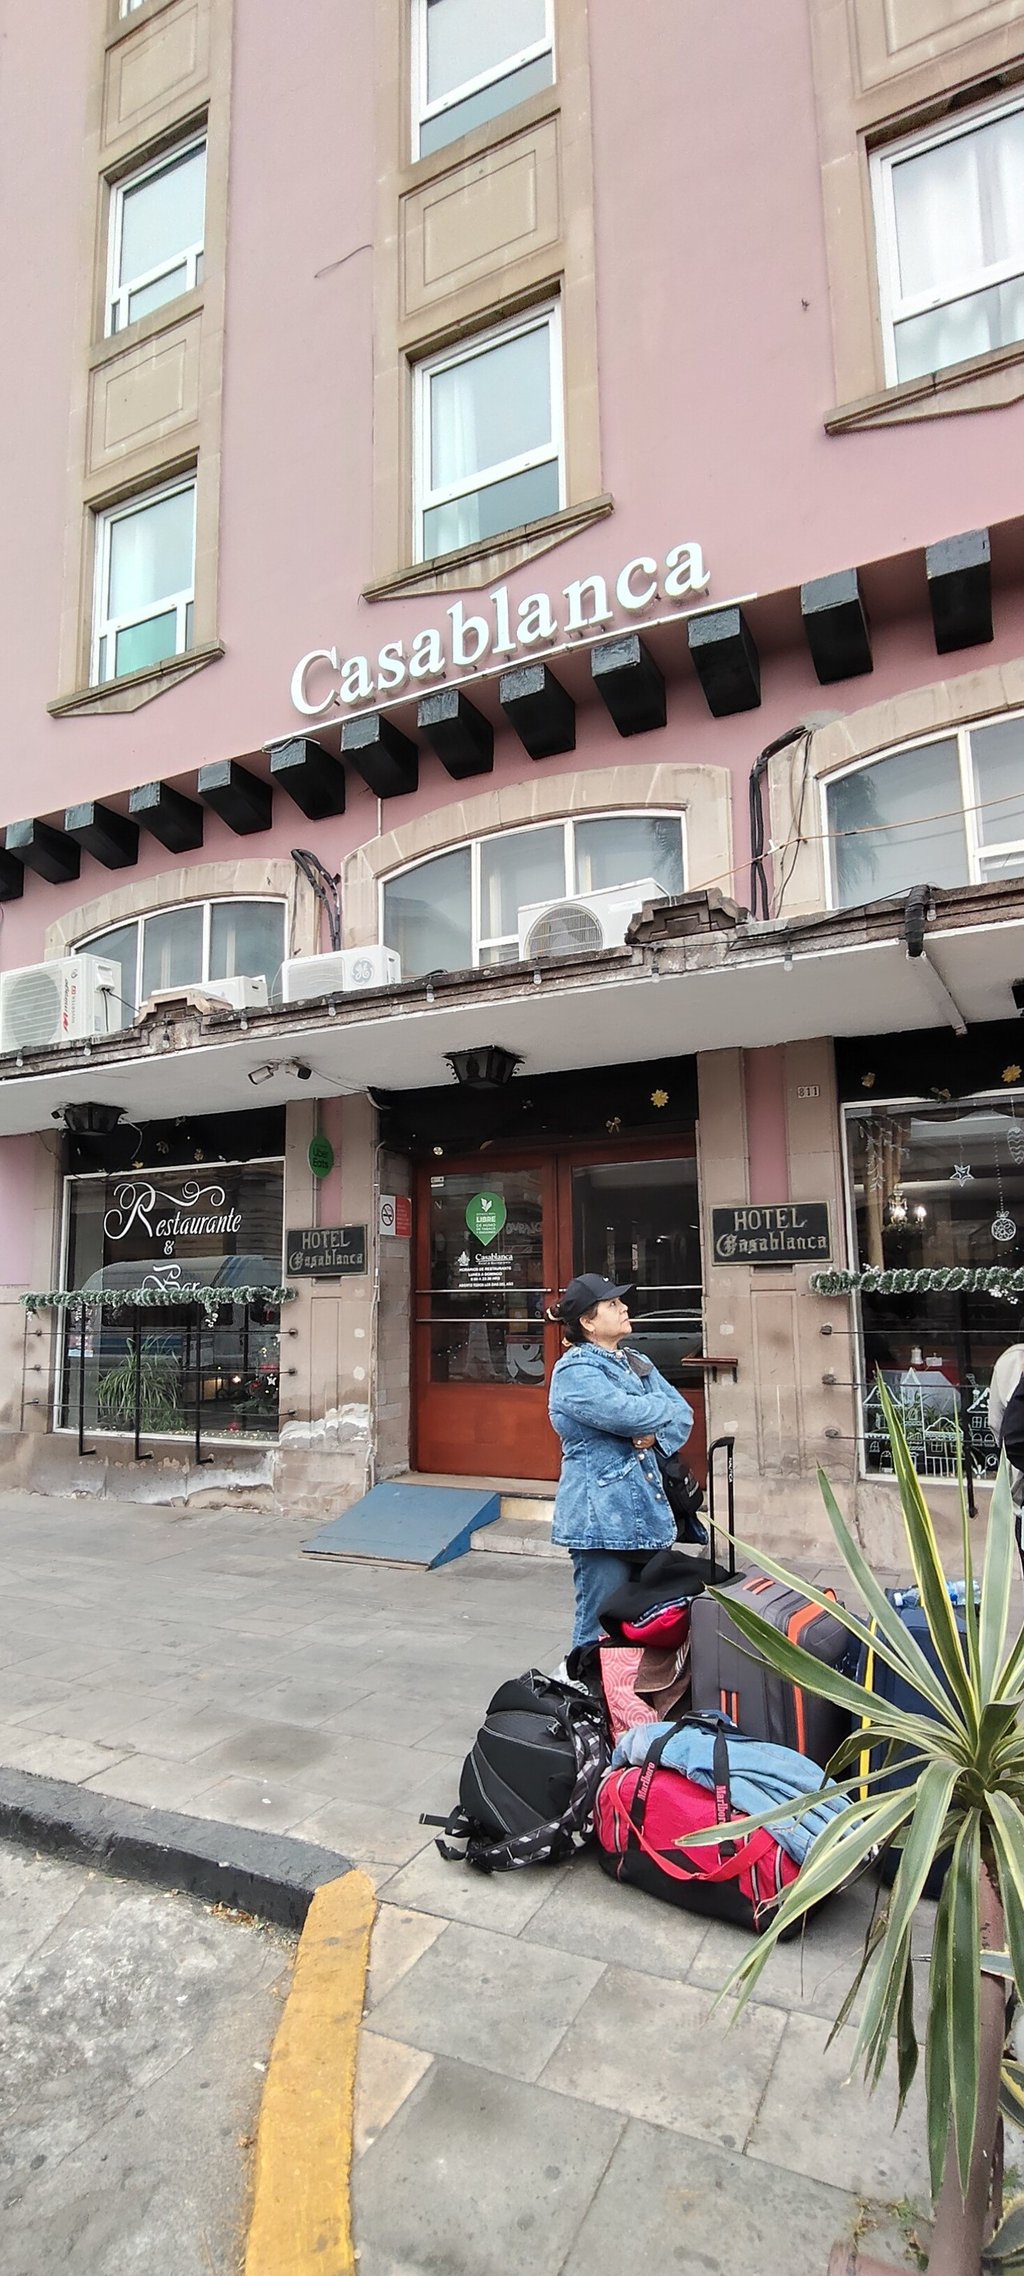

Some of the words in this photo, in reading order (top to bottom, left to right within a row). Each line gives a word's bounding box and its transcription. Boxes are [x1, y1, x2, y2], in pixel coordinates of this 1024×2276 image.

[290, 541, 711, 716] Casablanca
[312, 1146, 329, 1158] Uber
[312, 1157, 329, 1169] Eats
[103, 1181, 242, 1240] Restaurante
[734, 1207, 807, 1231] HOTEL
[163, 1240, 175, 1255] &
[302, 1230, 351, 1250] HOTEL
[716, 1231, 827, 1257] Casablanca
[289, 1249, 363, 1271] Casablanca
[475, 1253, 513, 1261] Casablanca
[637, 1761, 656, 1801] Marlboro
[715, 1784, 729, 1823] Marlbor
